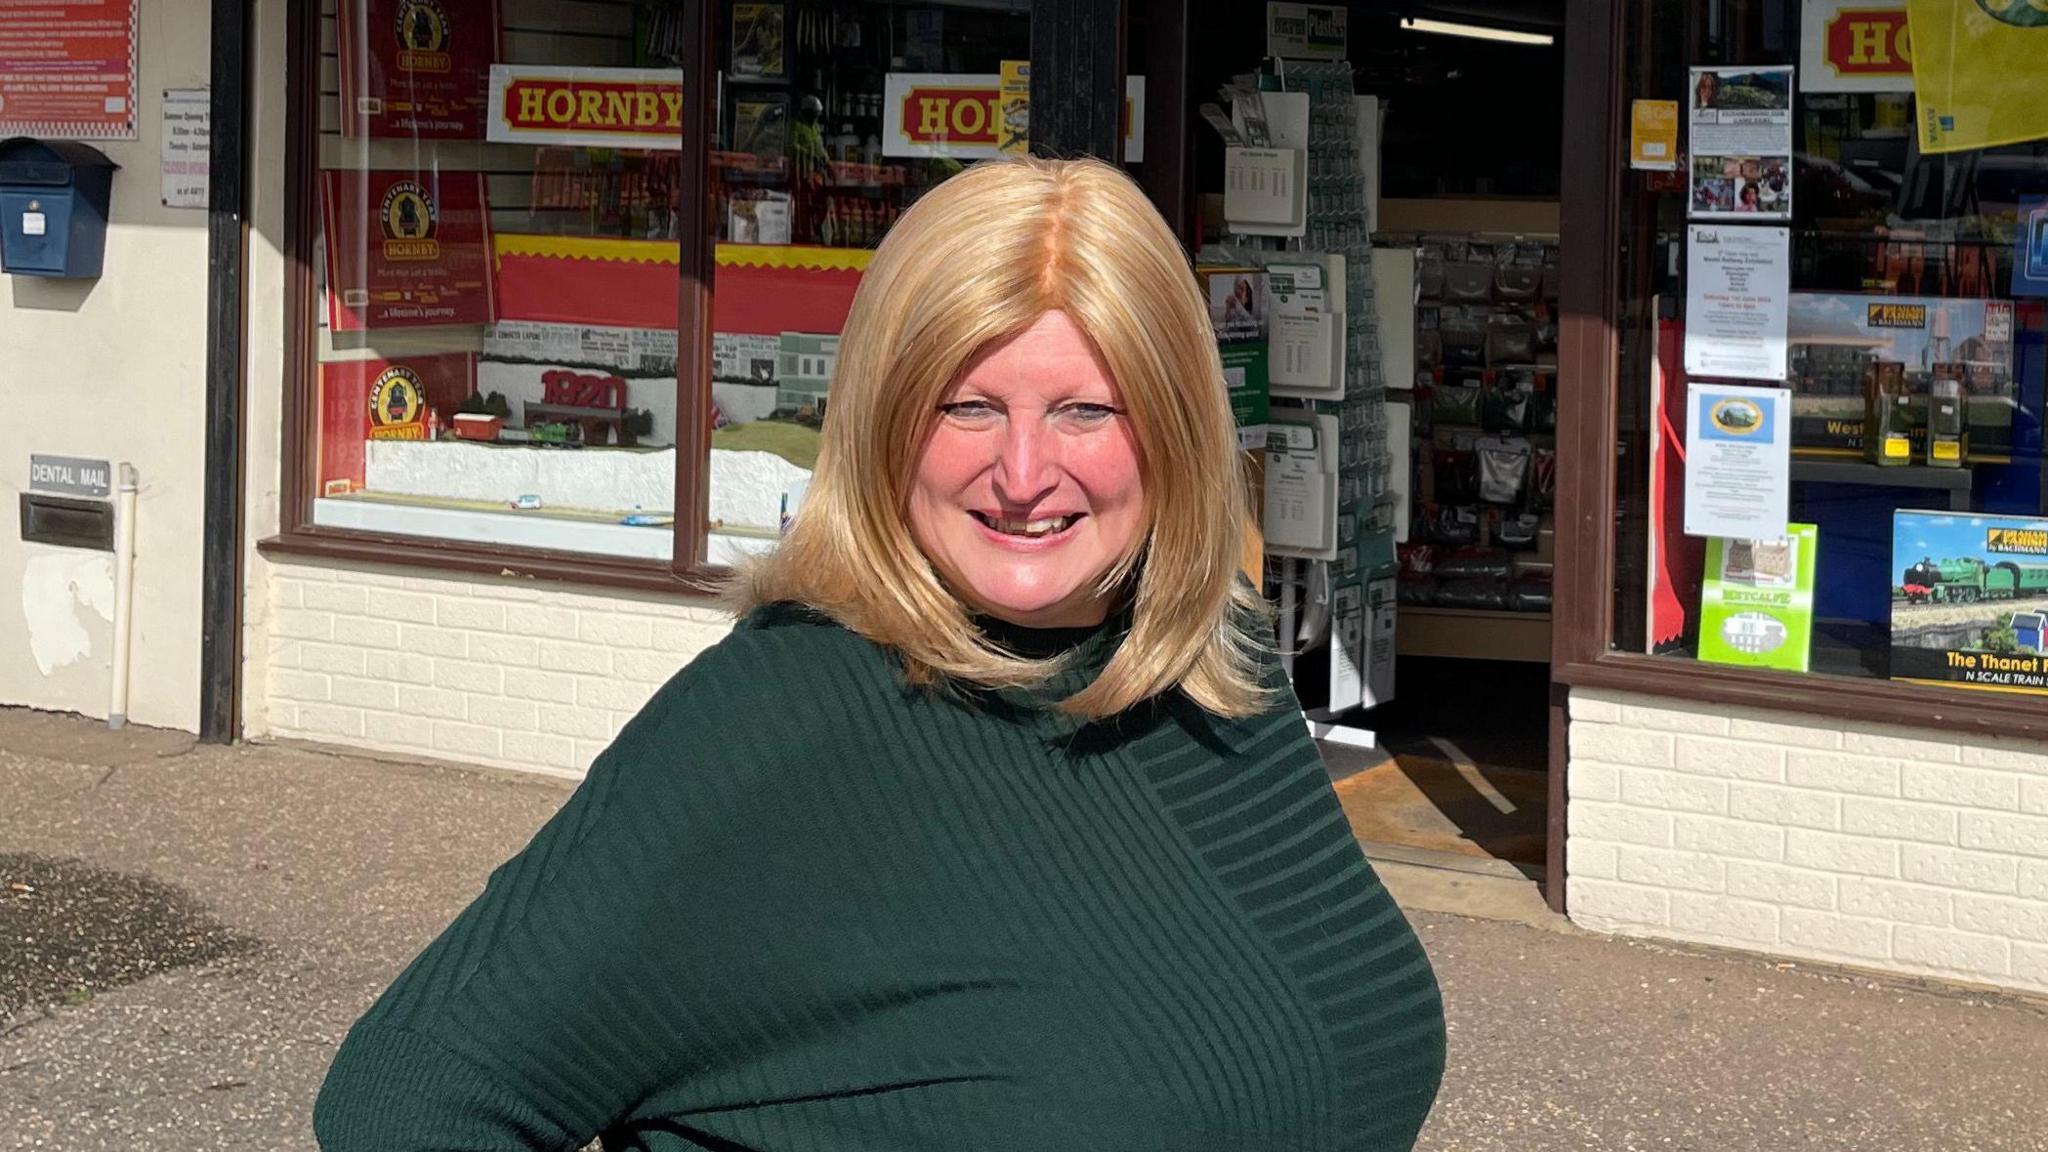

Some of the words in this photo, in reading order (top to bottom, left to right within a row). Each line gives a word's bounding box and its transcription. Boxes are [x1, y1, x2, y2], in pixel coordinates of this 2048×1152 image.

[518, 88, 682, 126] HORNBY
[388, 243, 434, 256] HORNBY
[32, 464, 75, 485] DENTAL
[80, 468, 108, 488] MAIL
[1947, 652, 1976, 667] The
[1981, 654, 2038, 672] Thanet
[1966, 671, 1975, 681] N
[1977, 671, 2010, 683] SCALE
[2013, 673, 2044, 685] TRAIN
